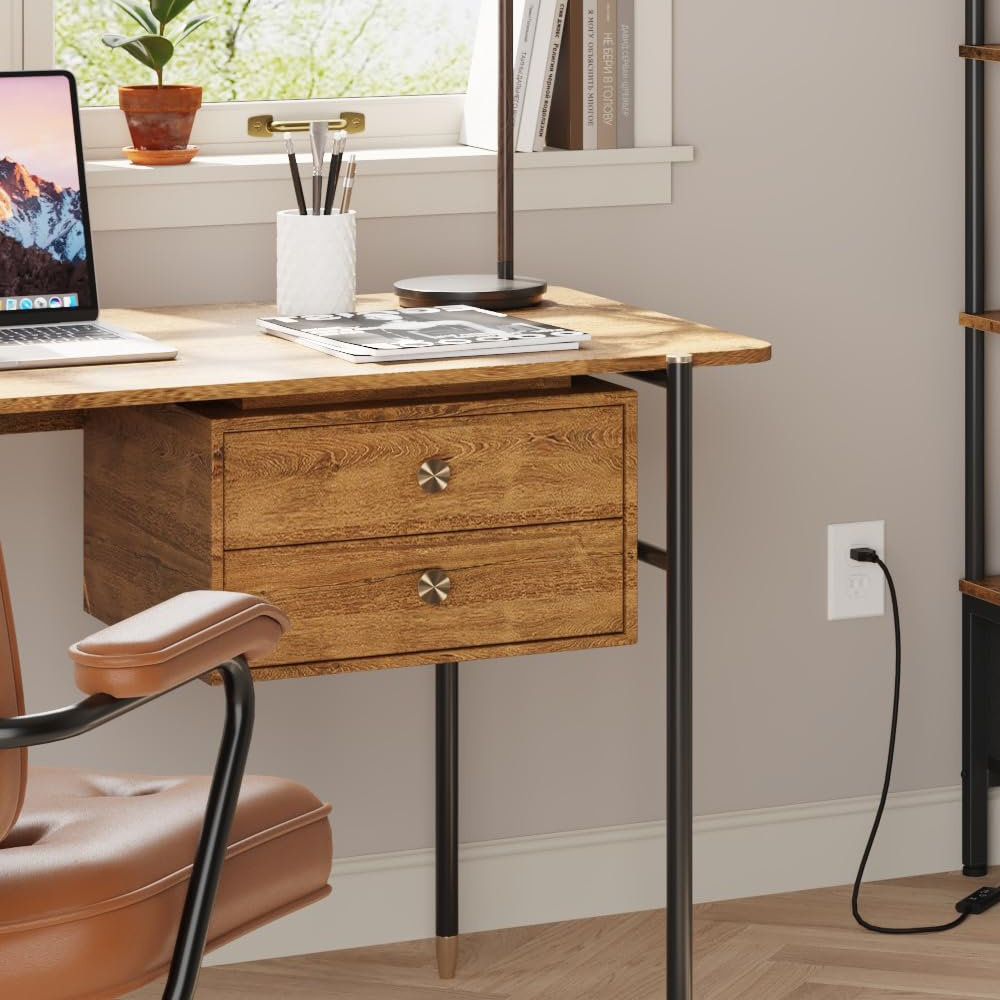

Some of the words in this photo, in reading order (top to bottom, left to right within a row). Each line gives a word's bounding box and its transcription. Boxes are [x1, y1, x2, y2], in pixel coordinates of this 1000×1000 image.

[603, 32, 614, 46] НЕ
[603, 48, 614, 74] БЕРИ
[603, 86, 614, 126] ГОЛОВУ
